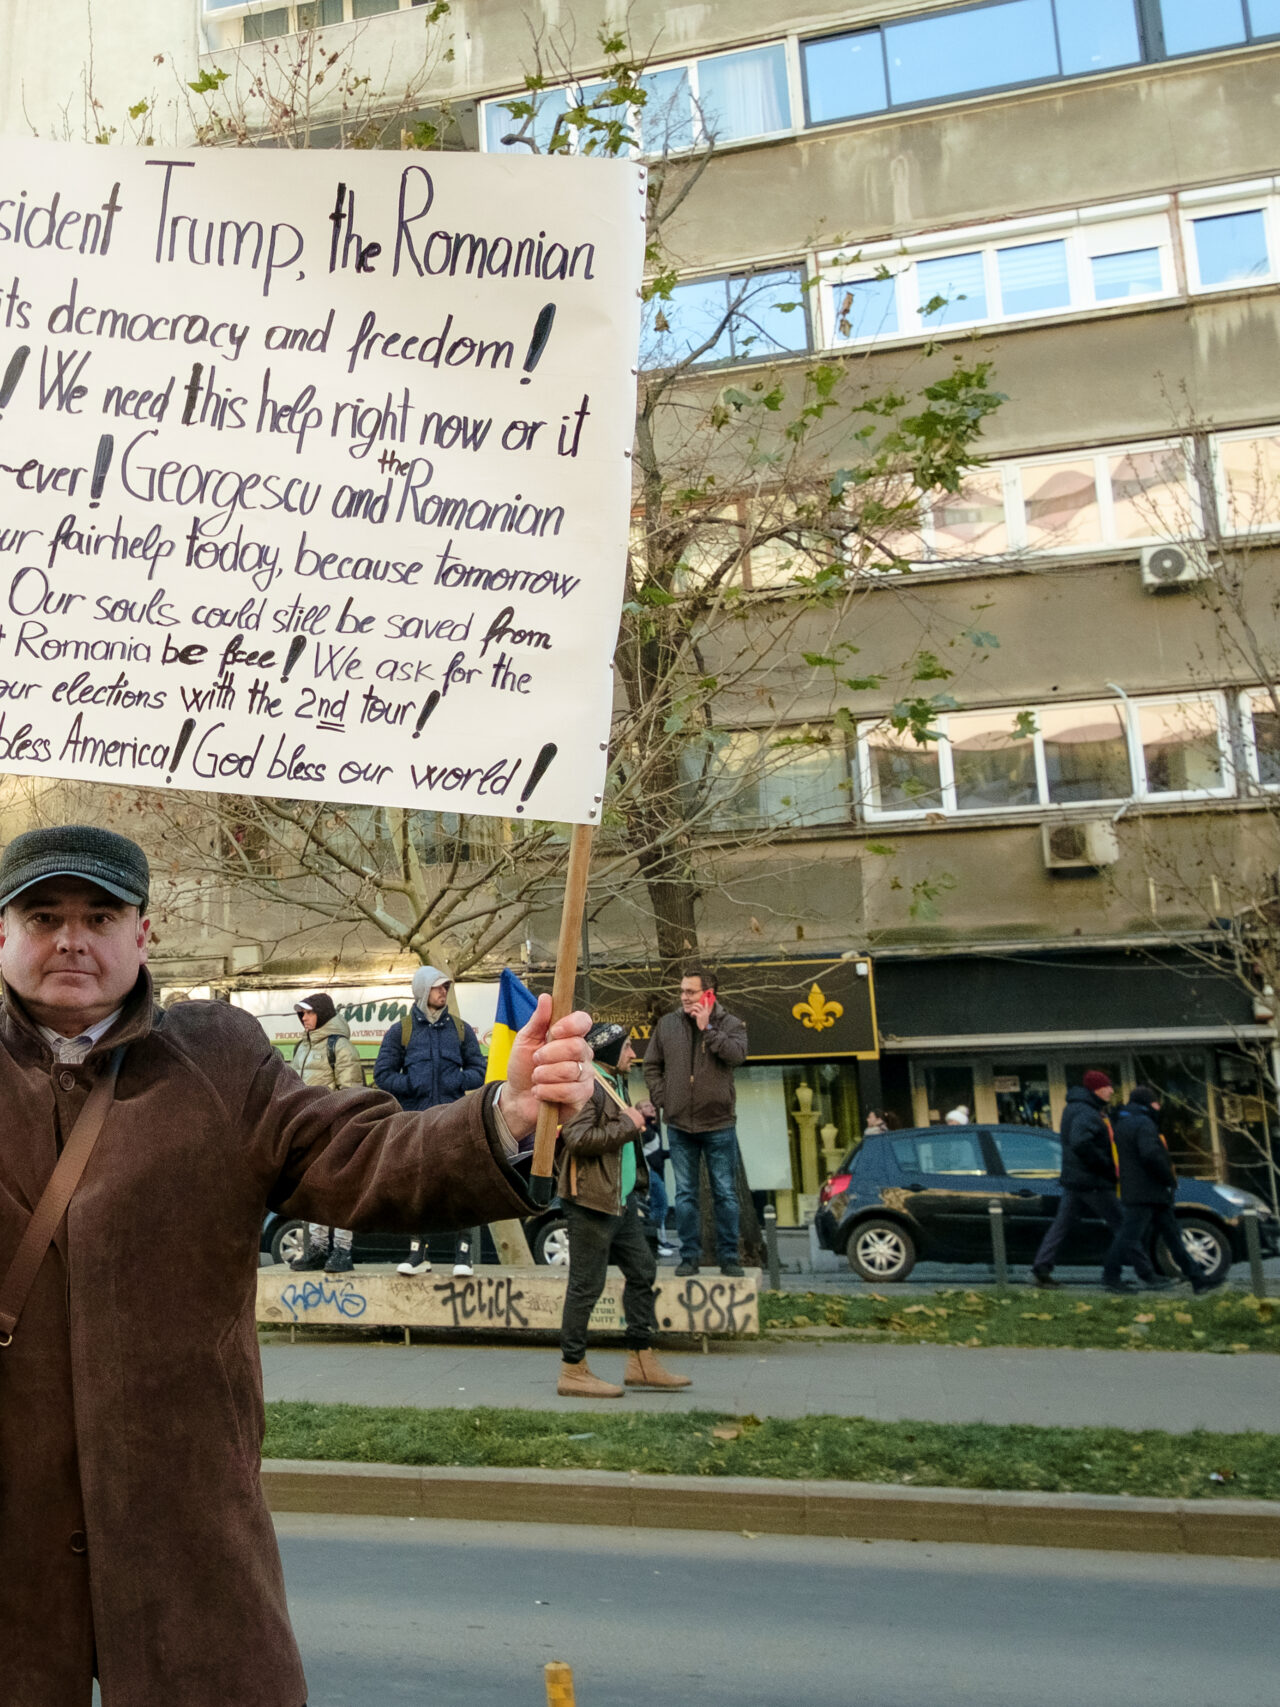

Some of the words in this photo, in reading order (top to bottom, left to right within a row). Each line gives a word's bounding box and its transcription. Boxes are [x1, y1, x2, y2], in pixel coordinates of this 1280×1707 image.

[145, 160, 306, 296] Trump,
[329, 182, 382, 274] the
[393, 165, 594, 280] Romanian
[48, 277, 250, 360] democracy
[264, 308, 335, 354] and
[347, 303, 556, 385] freedom!
[38, 345, 91, 415] We
[102, 376, 176, 422] need
[181, 362, 248, 433] this
[256, 367, 322, 455] help
[331, 387, 415, 459] right
[420, 412, 493, 452] now
[501, 420, 548, 451] or
[557, 394, 591, 458] it
[122, 429, 321, 537] Georgescu
[331, 477, 393, 525] and
[395, 457, 565, 538] Romanian
[378, 449, 410, 477] the
[185, 516, 283, 591] today,
[294, 531, 424, 586] because
[433, 538, 581, 599] tomorrow
[8, 565, 87, 617] Our
[93, 588, 180, 627] souls
[191, 597, 267, 632] could
[272, 592, 332, 635] still
[335, 596, 375, 635] be
[384, 612, 475, 642] saved
[480, 605, 553, 659] from
[13, 619, 151, 663] Romania
[161, 633, 209, 666] be
[313, 643, 364, 682] We
[375, 660, 436, 683] ask
[441, 651, 482, 698] for
[491, 656, 534, 696] the
[51, 671, 166, 710] elections
[179, 670, 237, 713] with
[248, 678, 284, 720] the
[293, 687, 350, 724] 2nd
[359, 684, 442, 740] tour!
[58, 712, 196, 783] America!
[192, 723, 265, 778] God
[267, 733, 327, 784] bless
[338, 760, 393, 785] our
[410, 742, 558, 813] world!
